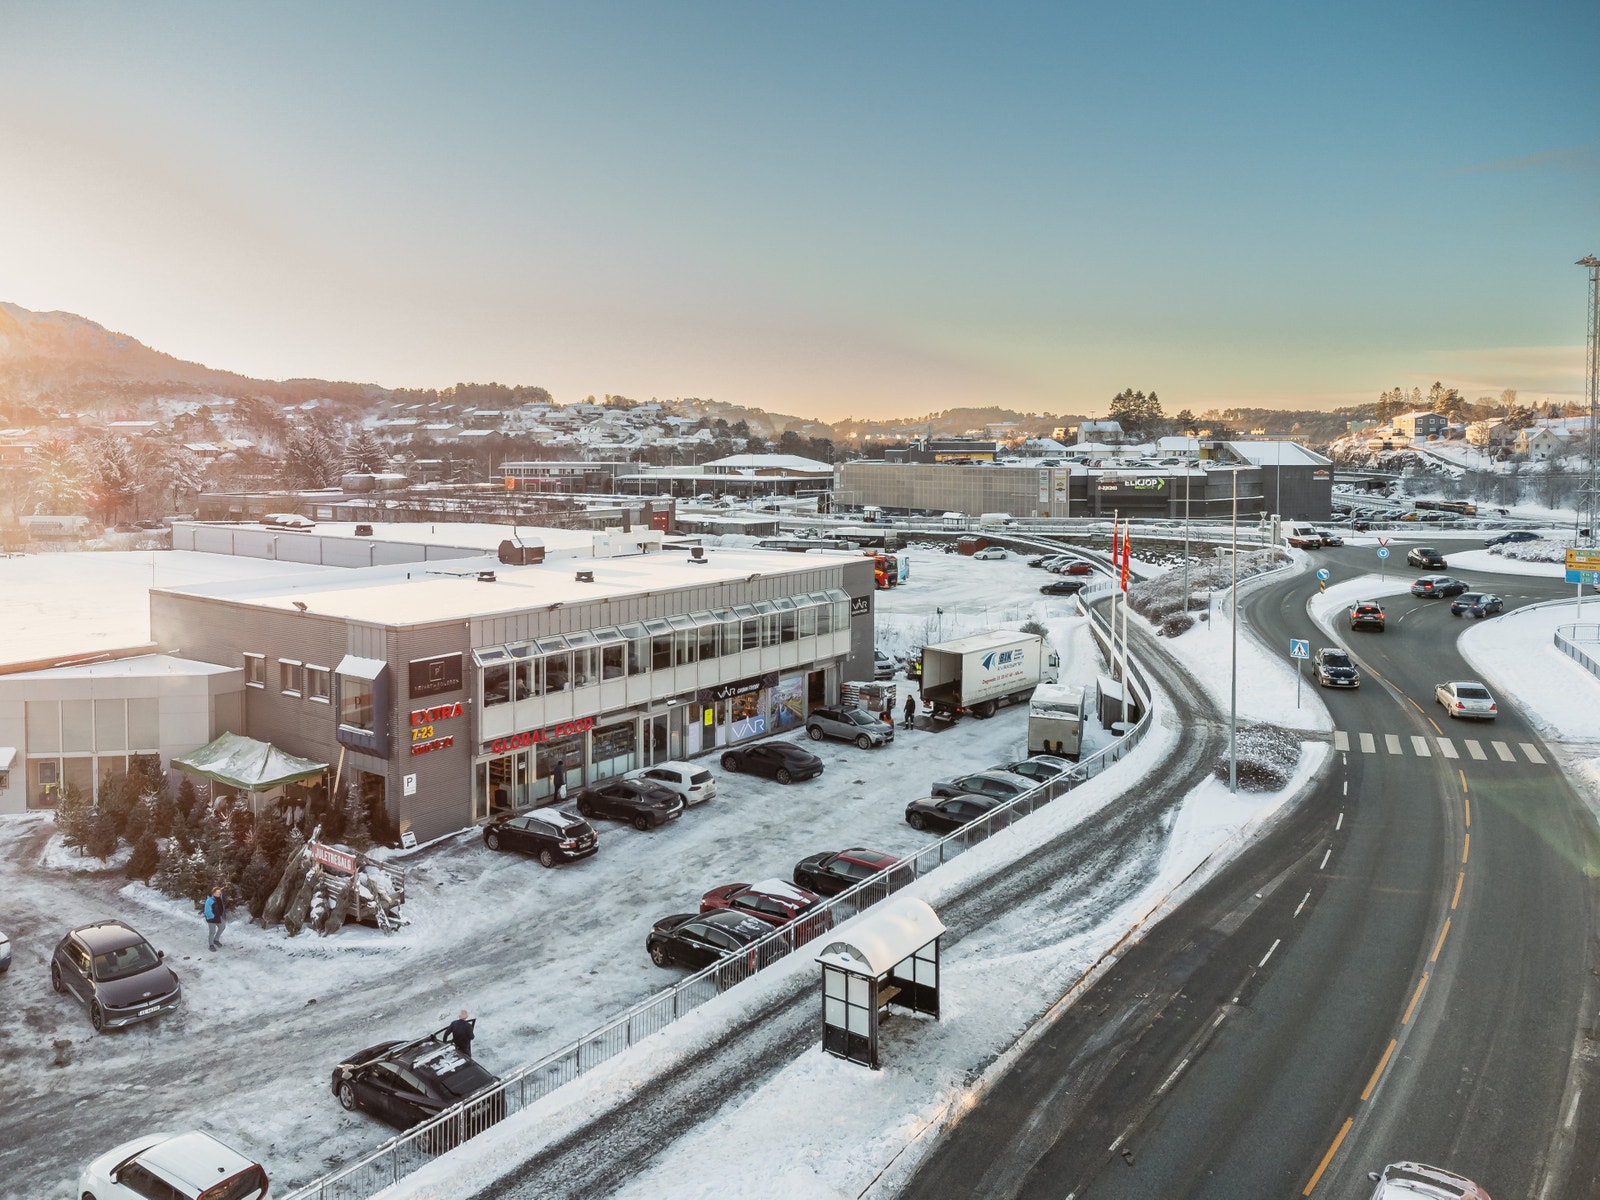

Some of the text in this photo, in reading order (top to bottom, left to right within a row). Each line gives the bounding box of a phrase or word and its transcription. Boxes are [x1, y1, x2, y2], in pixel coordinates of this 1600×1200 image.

[717, 686, 736, 698] VÅR
[411, 702, 464, 726] EXTRA
[411, 726, 434, 740] 7-23
[491, 717, 594, 754] GLOBAL FOOD
[732, 715, 765, 738] VÅR
[406, 777, 413, 787] P
